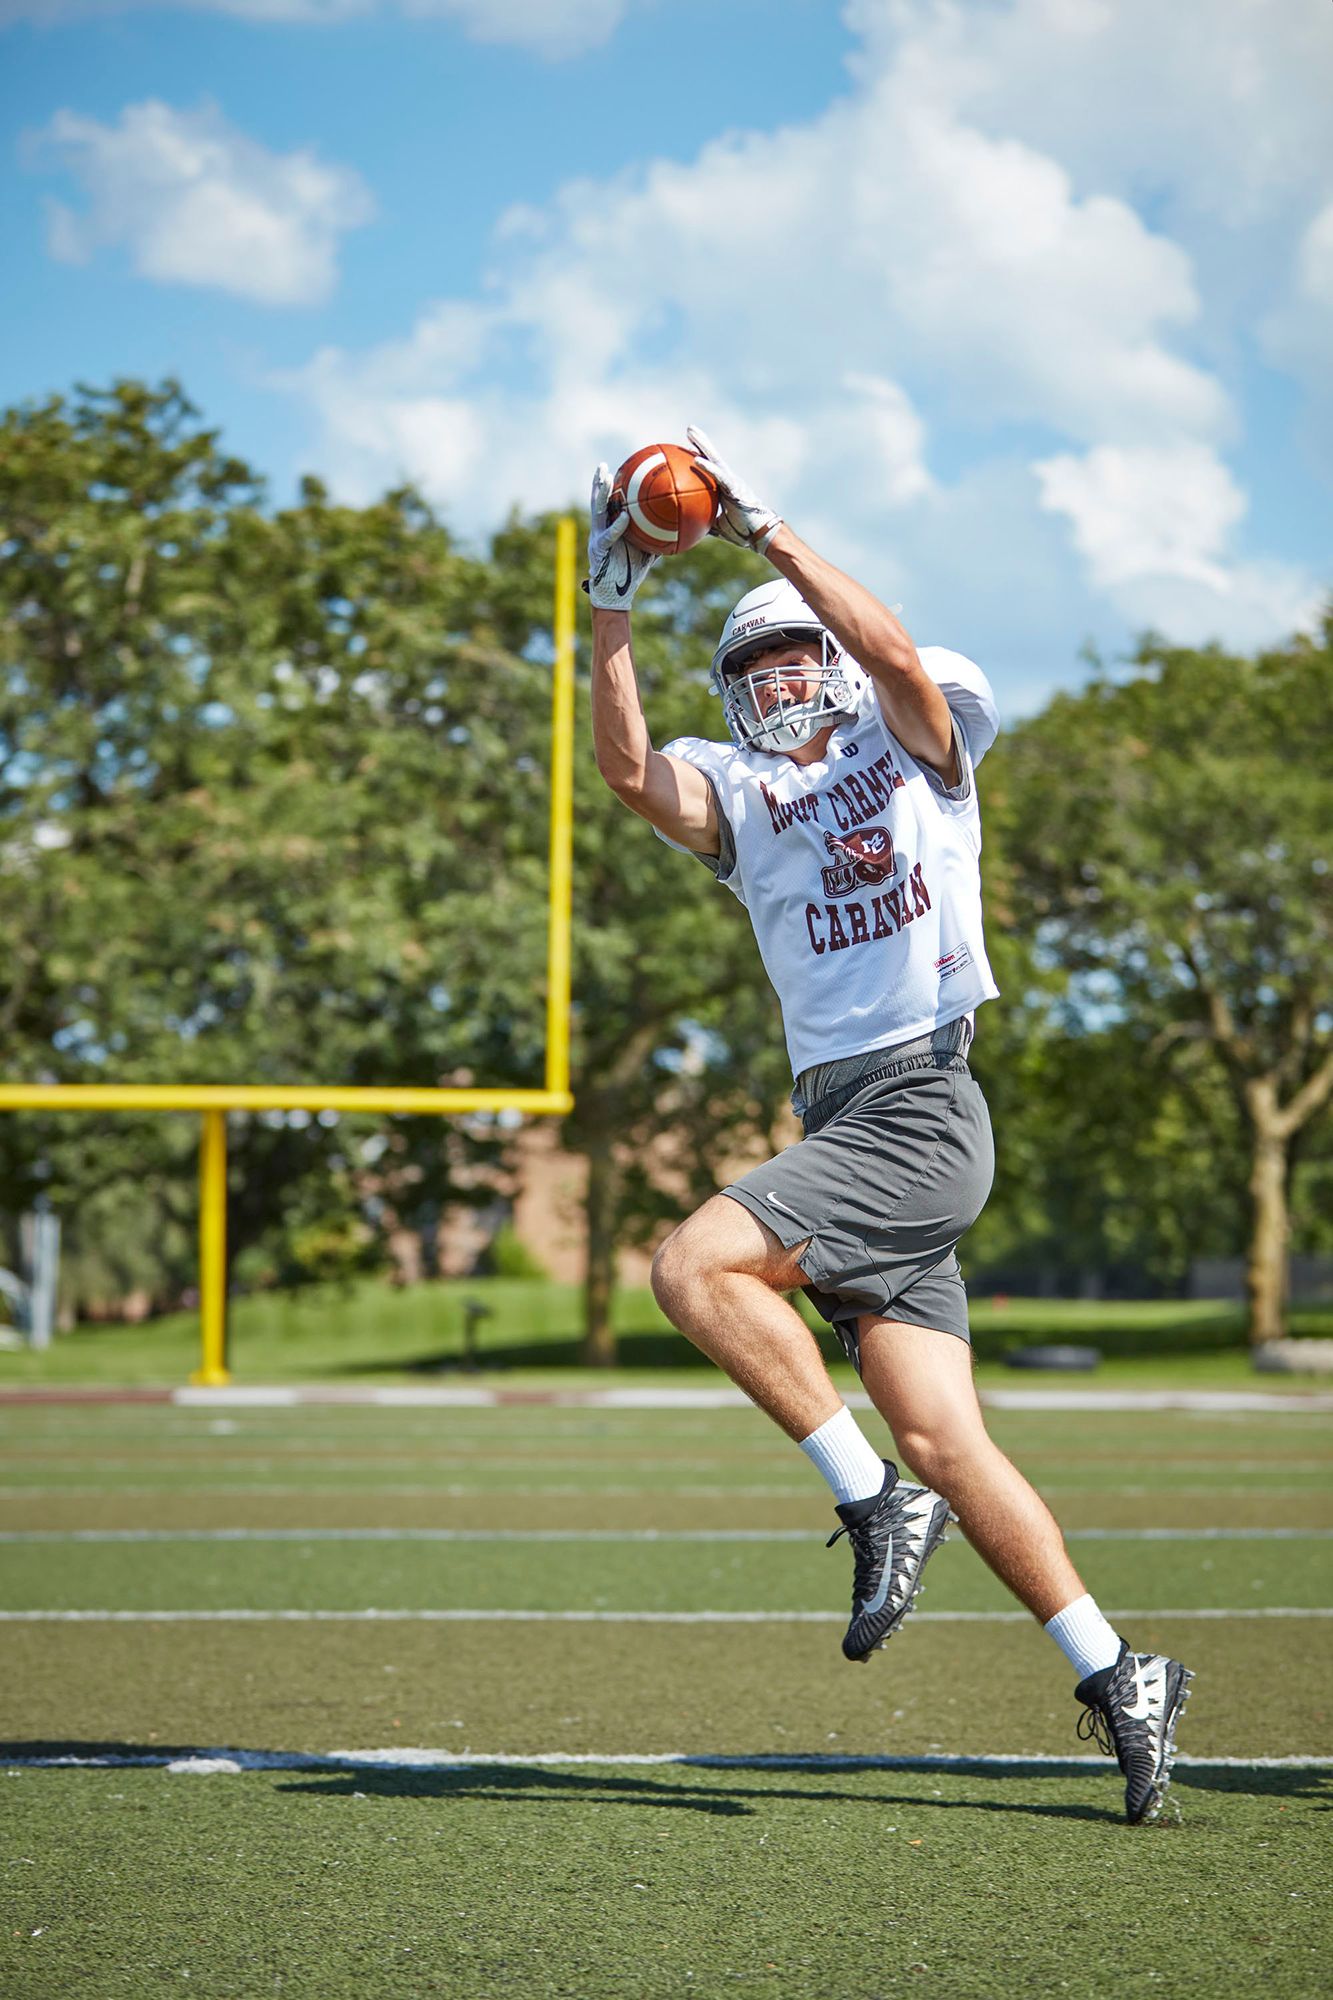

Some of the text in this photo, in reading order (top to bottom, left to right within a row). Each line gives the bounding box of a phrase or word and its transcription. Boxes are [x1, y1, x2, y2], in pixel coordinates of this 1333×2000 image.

[732, 616, 766, 636] CARAVAN
[760, 780, 819, 835] MOT
[805, 862, 931, 954] CARAVAN
